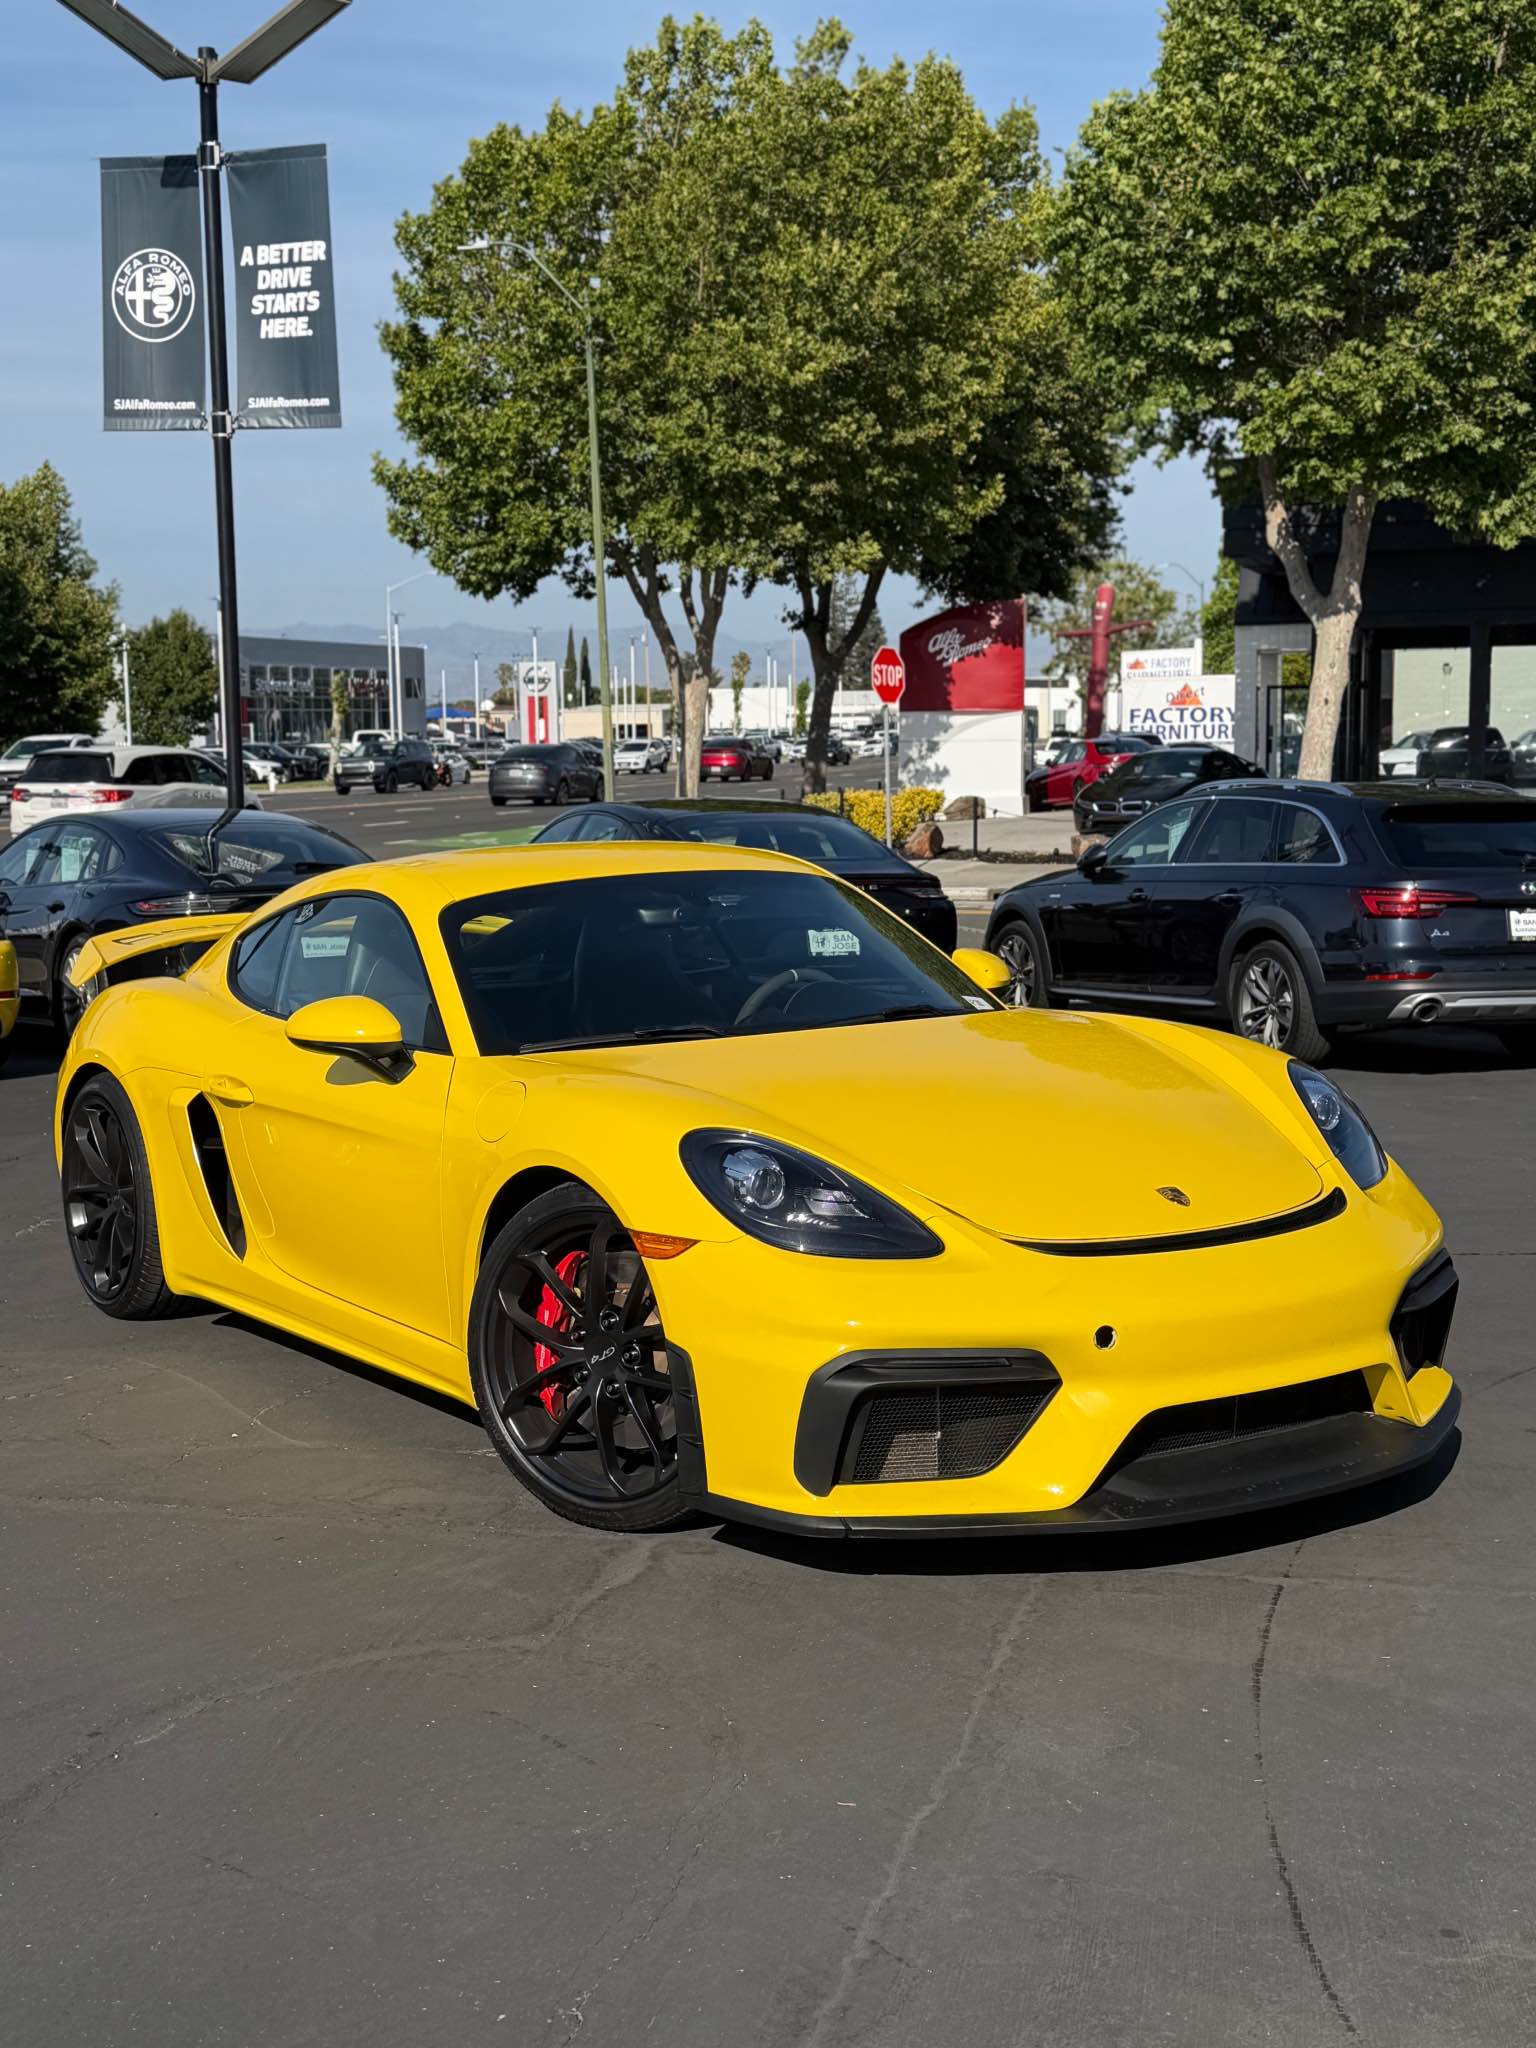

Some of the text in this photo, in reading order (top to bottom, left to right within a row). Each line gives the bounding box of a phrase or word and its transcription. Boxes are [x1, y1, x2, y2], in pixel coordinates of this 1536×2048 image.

[240, 240, 327, 266] A BETTER
[116, 253, 191, 296] ALFA ROMEO
[257, 266, 312, 290] DRIVE
[251, 290, 320, 315] STARTS
[260, 316, 314, 339] HERE.
[113, 398, 196, 410] SJAlfaRomeo.com
[248, 397, 330, 409] SJAlfaRomeo.com
[1151, 657, 1192, 669] FACTORY
[873, 664, 903, 687] STOP
[1129, 724, 1235, 740] FRNITUR
[833, 934, 854, 942] SAN
